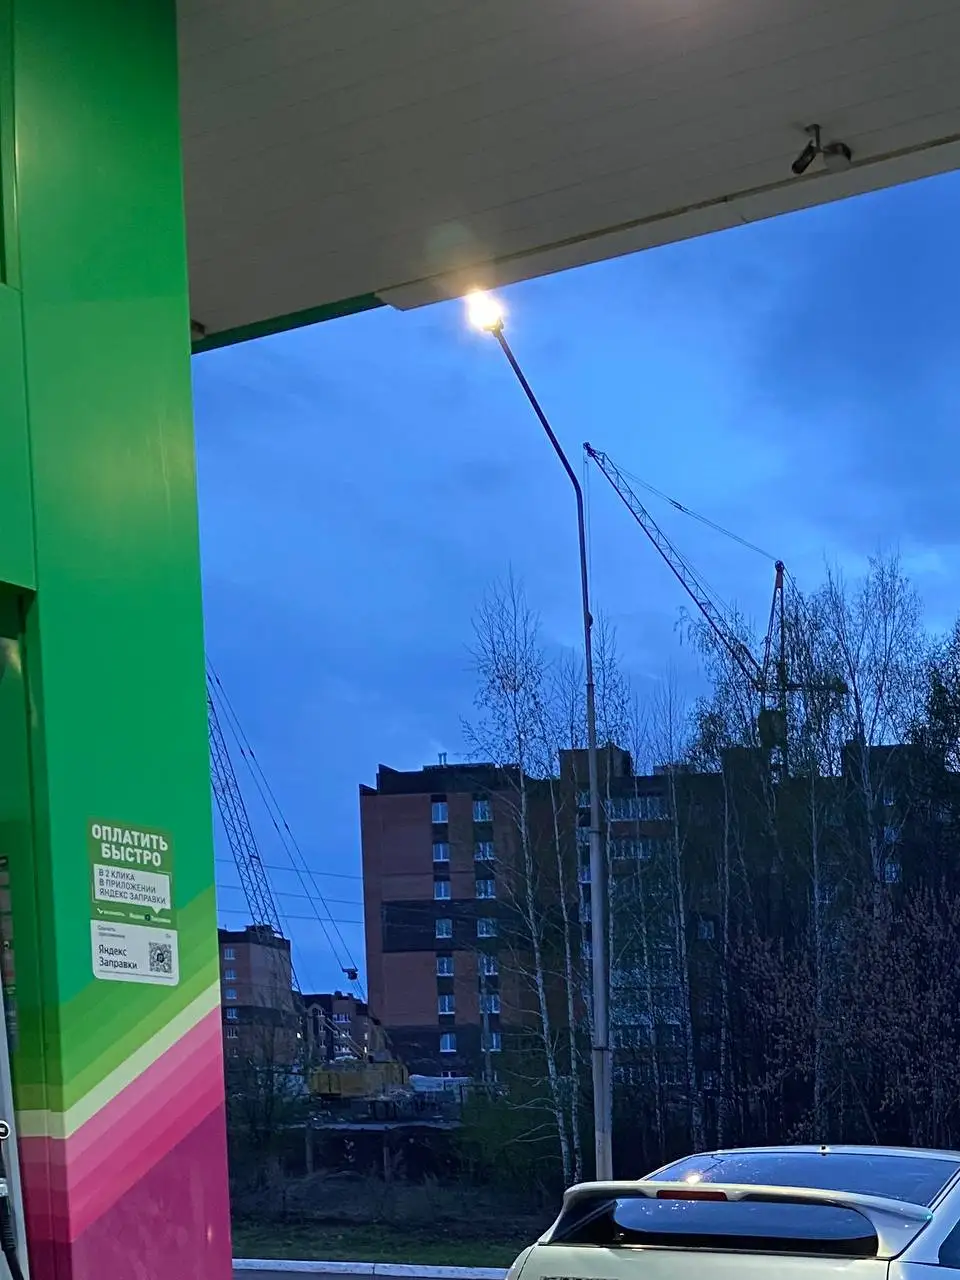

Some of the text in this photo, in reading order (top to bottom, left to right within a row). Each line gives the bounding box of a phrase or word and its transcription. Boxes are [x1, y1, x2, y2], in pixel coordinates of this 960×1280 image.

[92, 824, 168, 851] ОПЛАТИТЬ
[101, 843, 161, 867] БЫСТРО
[98, 869, 135, 881] В 2 КЛИКА
[99, 879, 156, 894] В ПРИЛОЖЕНИИ
[99, 888, 166, 905] ЯНДЕКС ЗАПРАВКИ
[98, 944, 127, 957] Яндекс
[99, 957, 138, 970] Заправки
